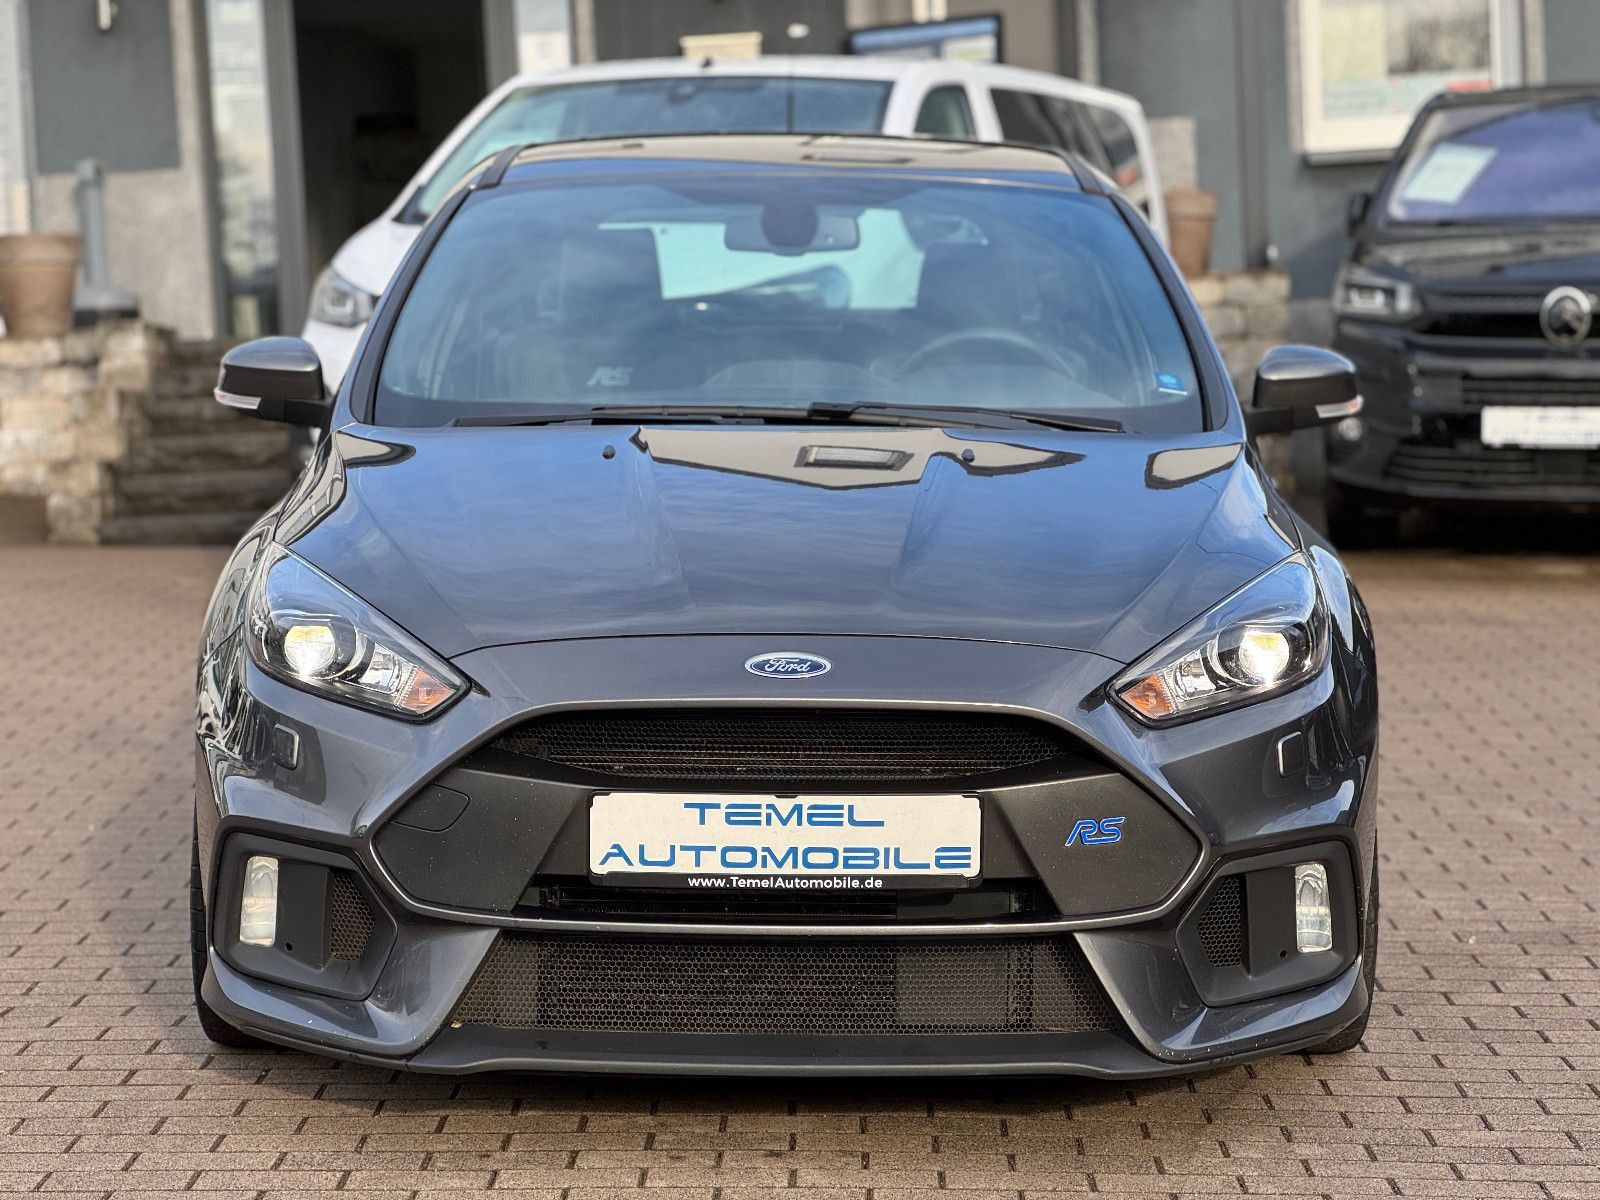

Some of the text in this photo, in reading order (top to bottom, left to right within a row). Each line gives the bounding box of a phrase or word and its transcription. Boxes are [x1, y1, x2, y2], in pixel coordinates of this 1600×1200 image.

[764, 658, 811, 671] Ford
[683, 802, 885, 827] TEMEL
[1064, 816, 1126, 847] RS
[598, 843, 972, 870] AUTOMOBILE
[687, 875, 883, 890] www.TemelAutomobile.de
